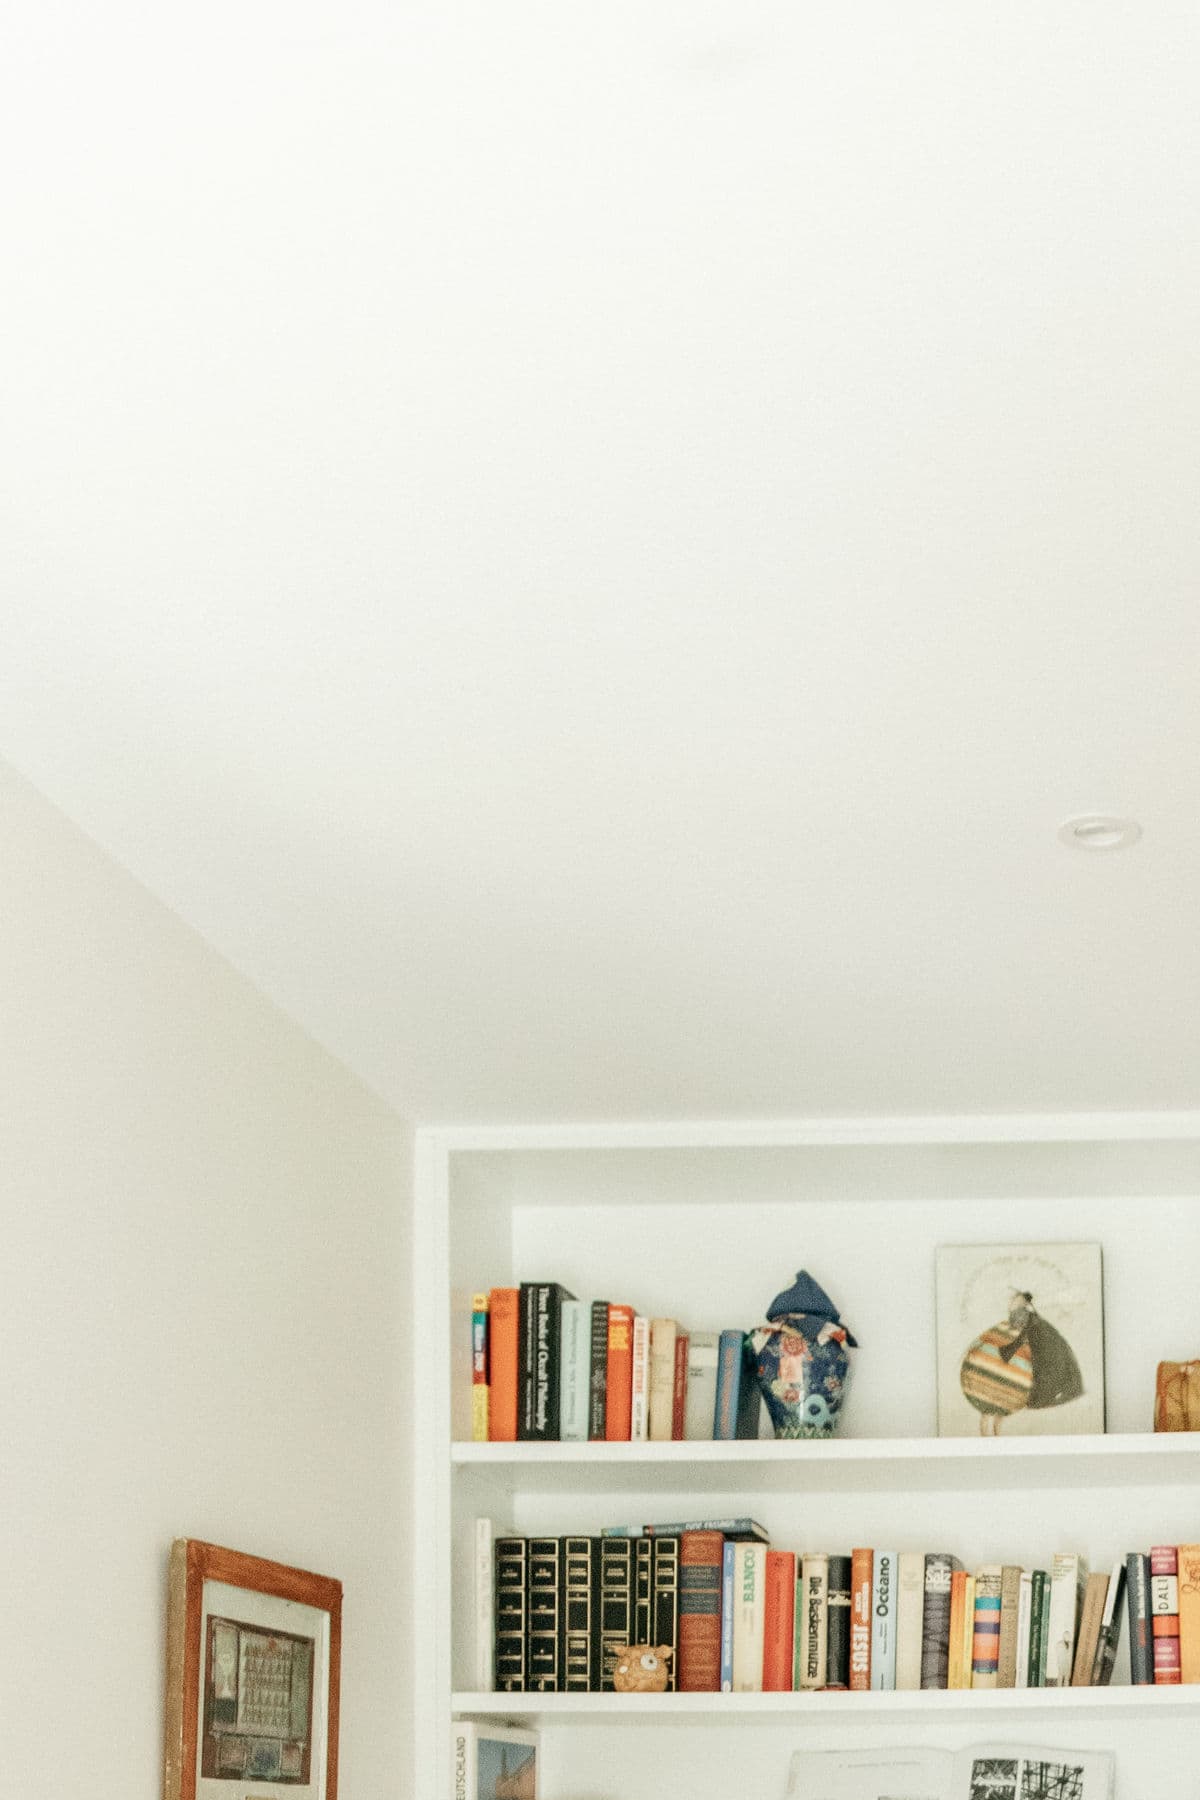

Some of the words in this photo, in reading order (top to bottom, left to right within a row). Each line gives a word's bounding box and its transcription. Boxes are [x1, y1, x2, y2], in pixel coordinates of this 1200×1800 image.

[743, 1549, 756, 1603] BANCO
[809, 1577, 823, 1595] Die
[876, 1557, 890, 1617] Océano
[852, 1624, 870, 1672] JESUS
